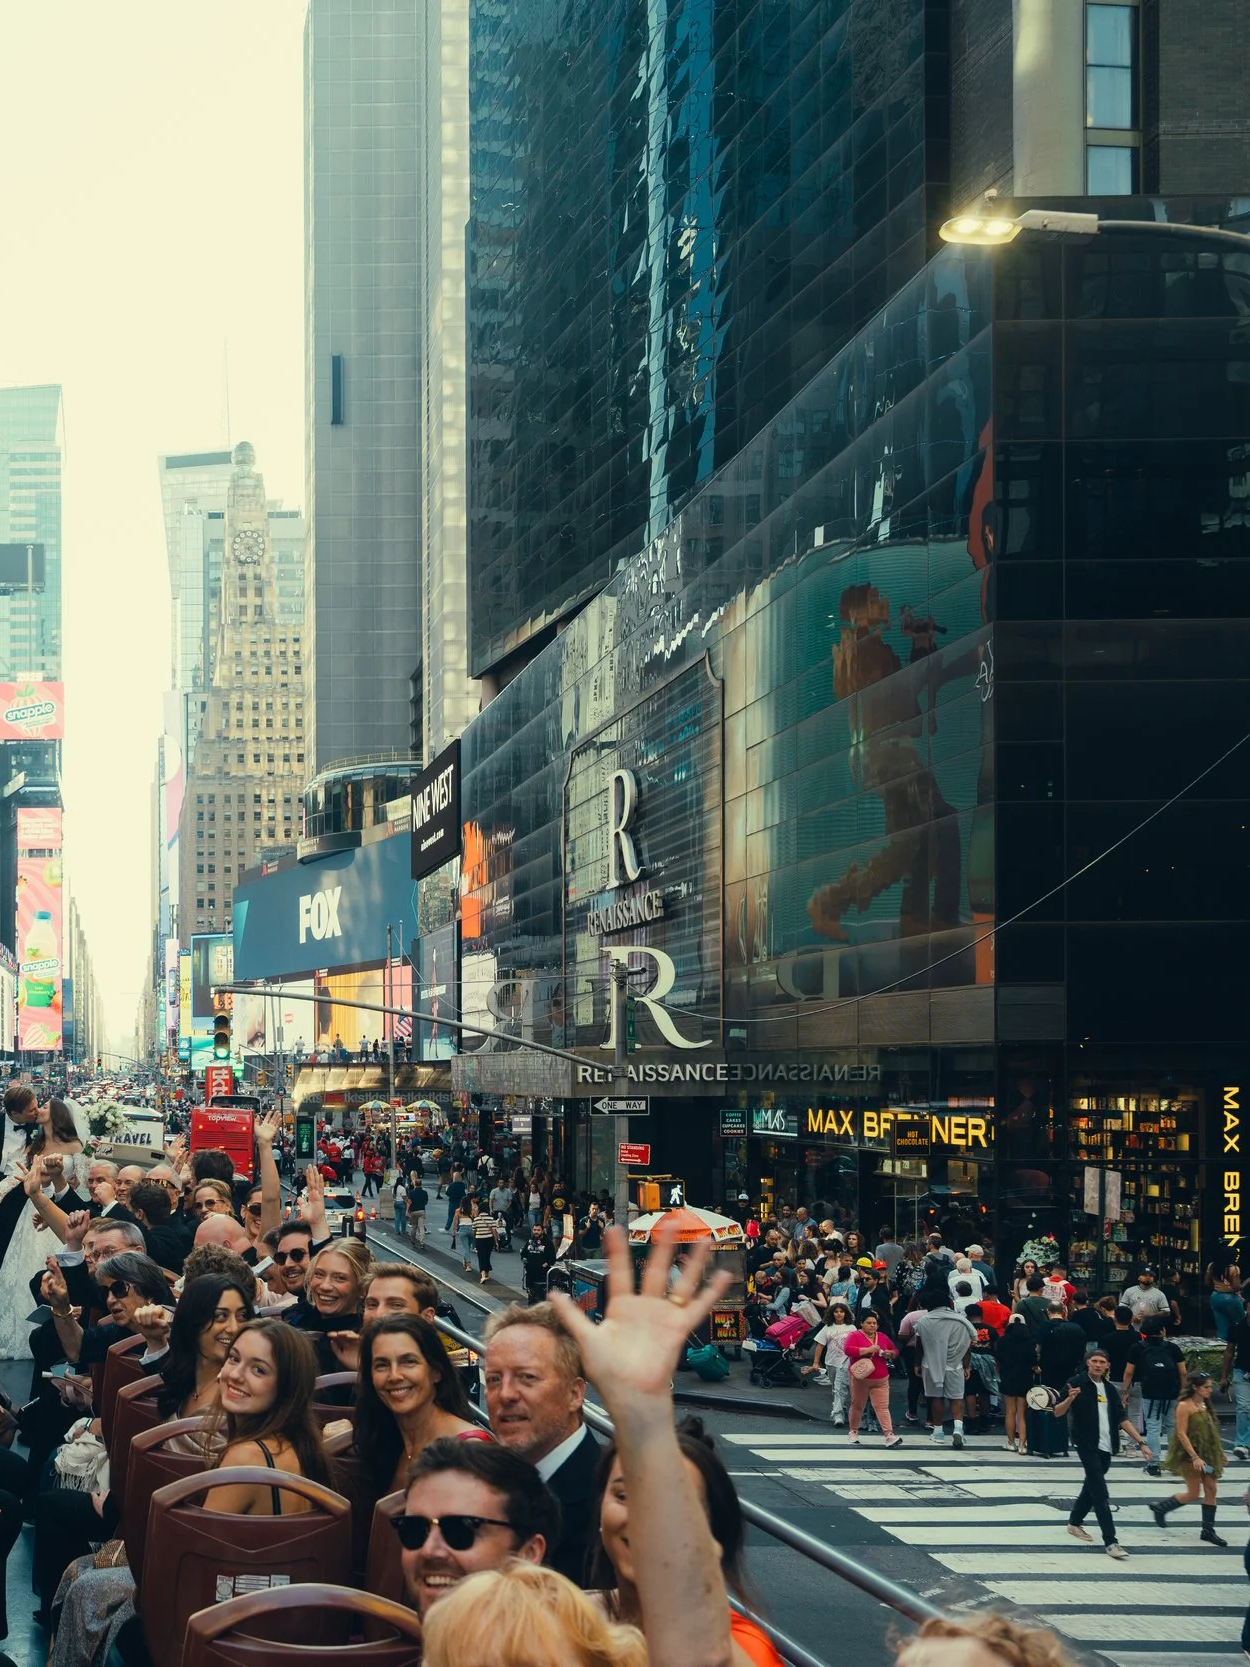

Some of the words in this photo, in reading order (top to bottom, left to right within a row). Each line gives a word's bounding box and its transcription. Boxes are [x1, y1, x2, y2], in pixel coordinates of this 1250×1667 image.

[6, 703, 53, 720] snapple
[412, 785, 431, 832] NINE
[431, 764, 454, 816] WEST
[606, 769, 647, 890] R
[299, 886, 342, 944] FOX
[587, 889, 662, 934] RENAISSANCE
[599, 946, 712, 1050] R
[602, 1100, 618, 1110] ONE
[625, 1101, 643, 1109] WAY
[808, 1108, 854, 1136] MAX
[863, 1111, 988, 1148] BRNER
[1224, 1087, 1240, 1153] MAX
[897, 1138, 929, 1146] CHOCOLATE
[907, 1131, 918, 1139] HOT
[715, 1314, 735, 1324] NUTS
[717, 1328, 737, 1338] NUTS
[723, 1321, 730, 1329] 4
